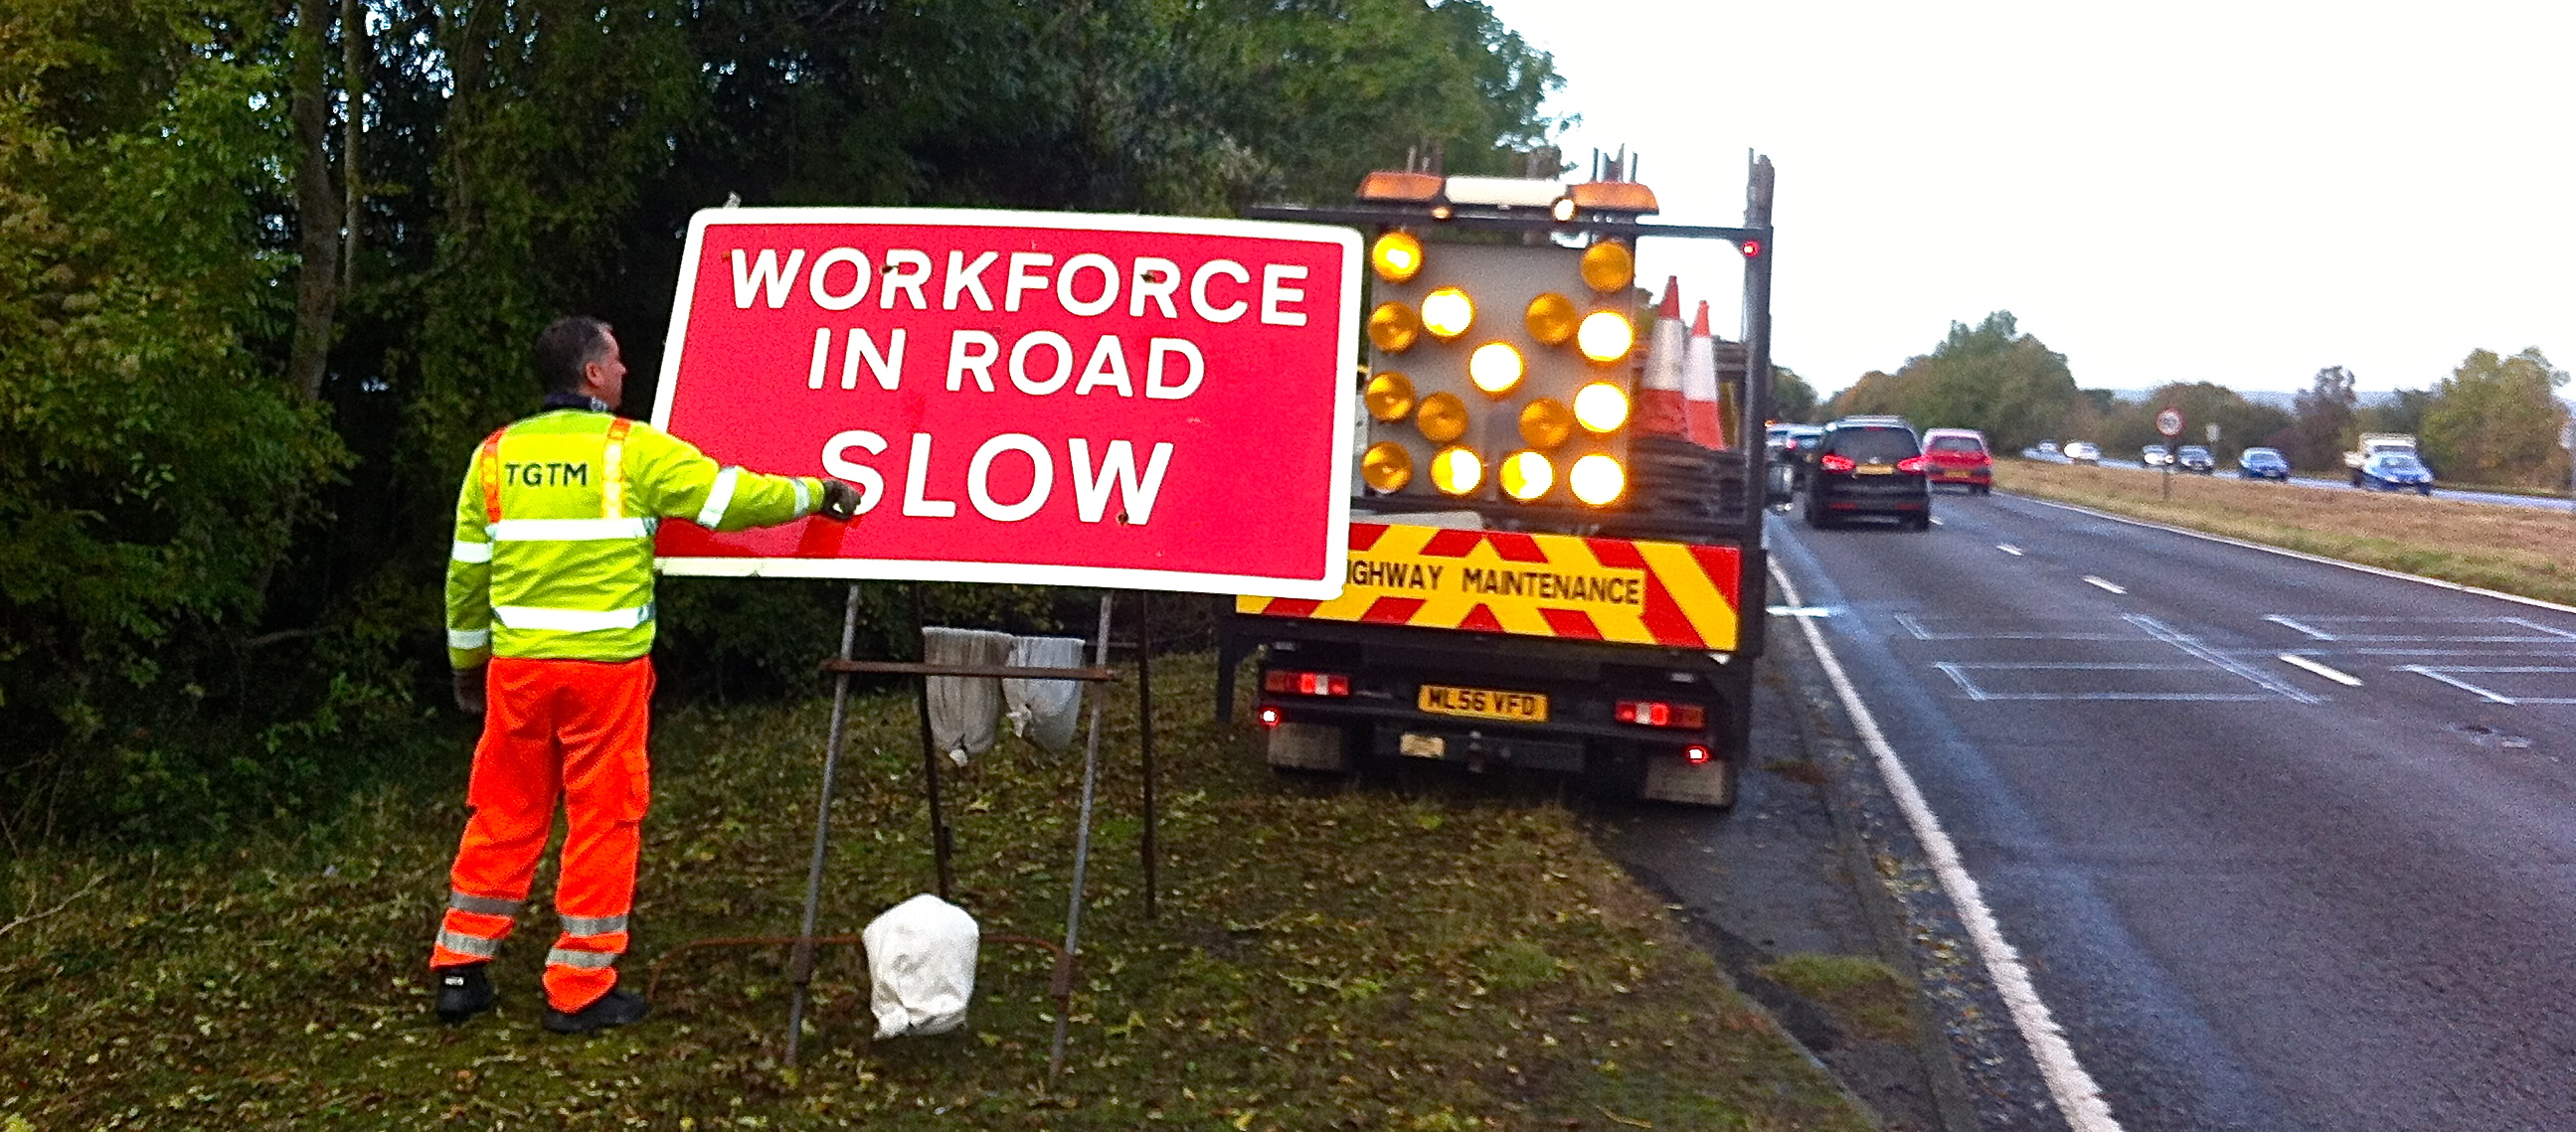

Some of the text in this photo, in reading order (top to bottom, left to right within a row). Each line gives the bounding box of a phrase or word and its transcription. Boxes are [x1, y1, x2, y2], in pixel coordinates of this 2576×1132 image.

[731, 247, 1309, 326] WORKFORCE
[806, 328, 1205, 401] IN ROAD
[504, 462, 587, 487] TGTM
[821, 429, 1174, 526] SLOW
[1347, 559, 1639, 605] IGHWAY MAINTENANCE
